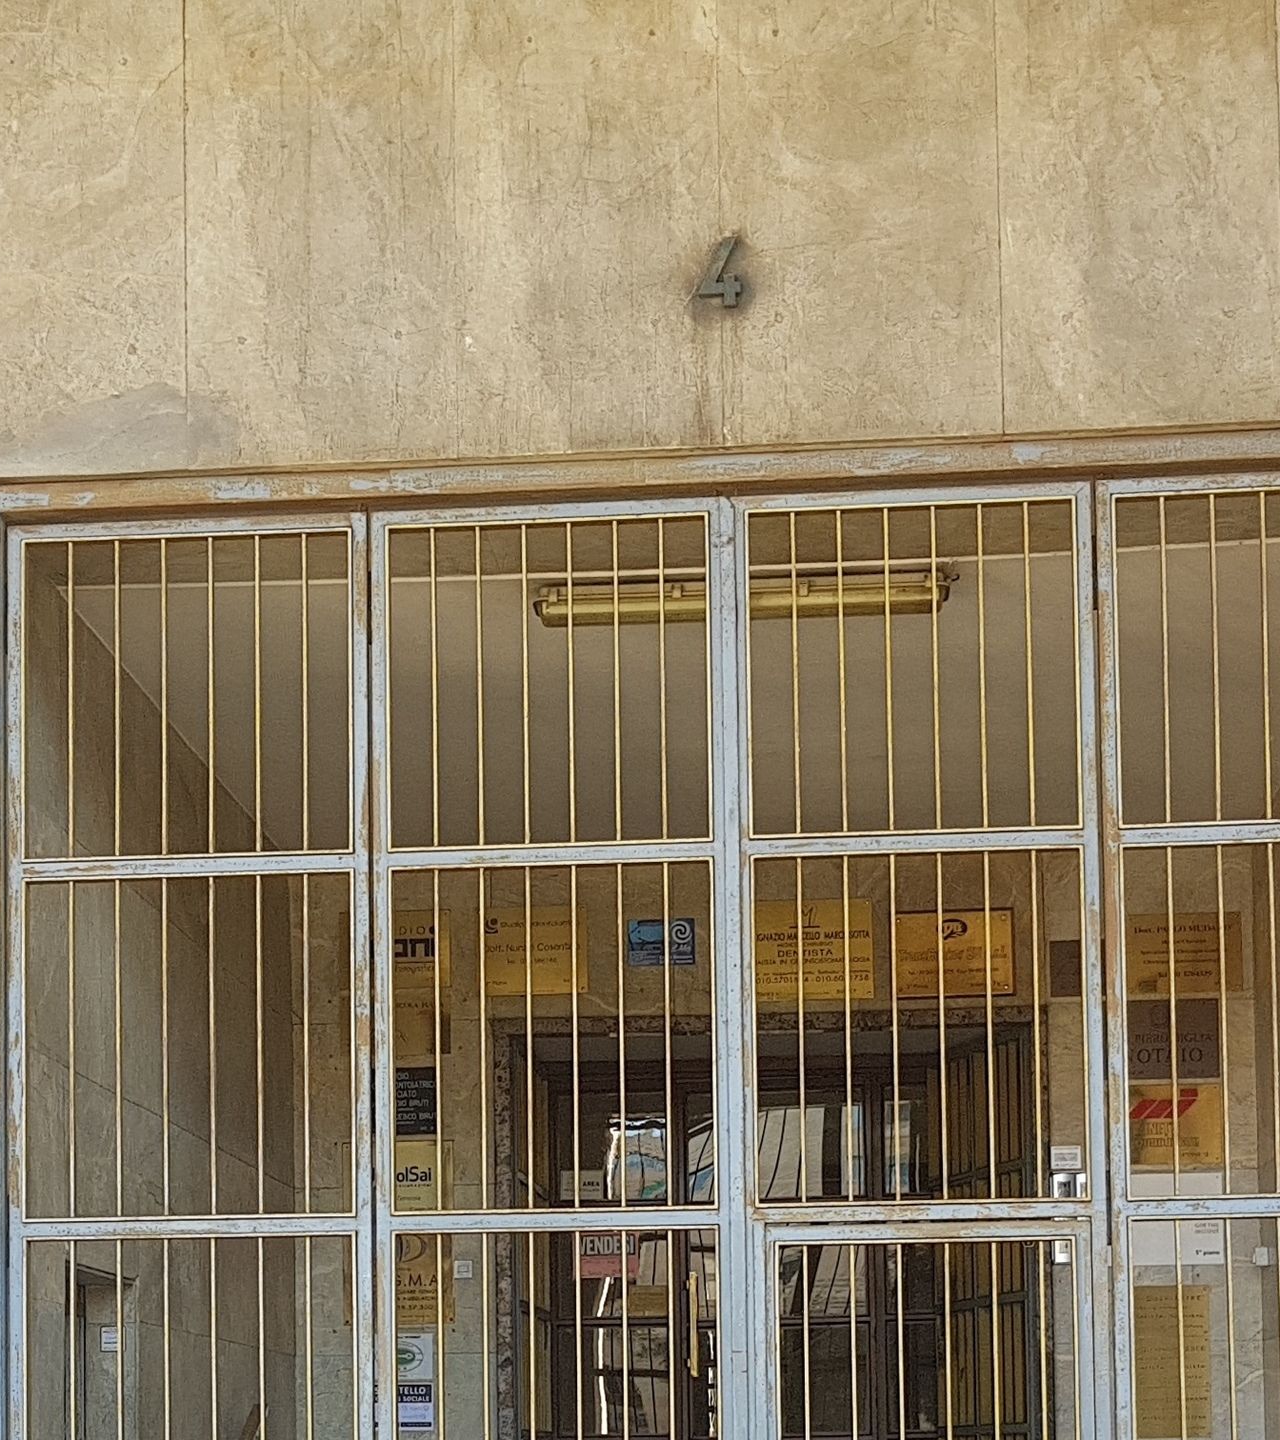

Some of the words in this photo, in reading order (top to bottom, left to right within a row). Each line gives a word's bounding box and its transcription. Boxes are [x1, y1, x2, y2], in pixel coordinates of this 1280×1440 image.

[698, 236, 742, 308] 4
[777, 948, 833, 958] DENTISTA
[396, 1166, 432, 1183] olSai
